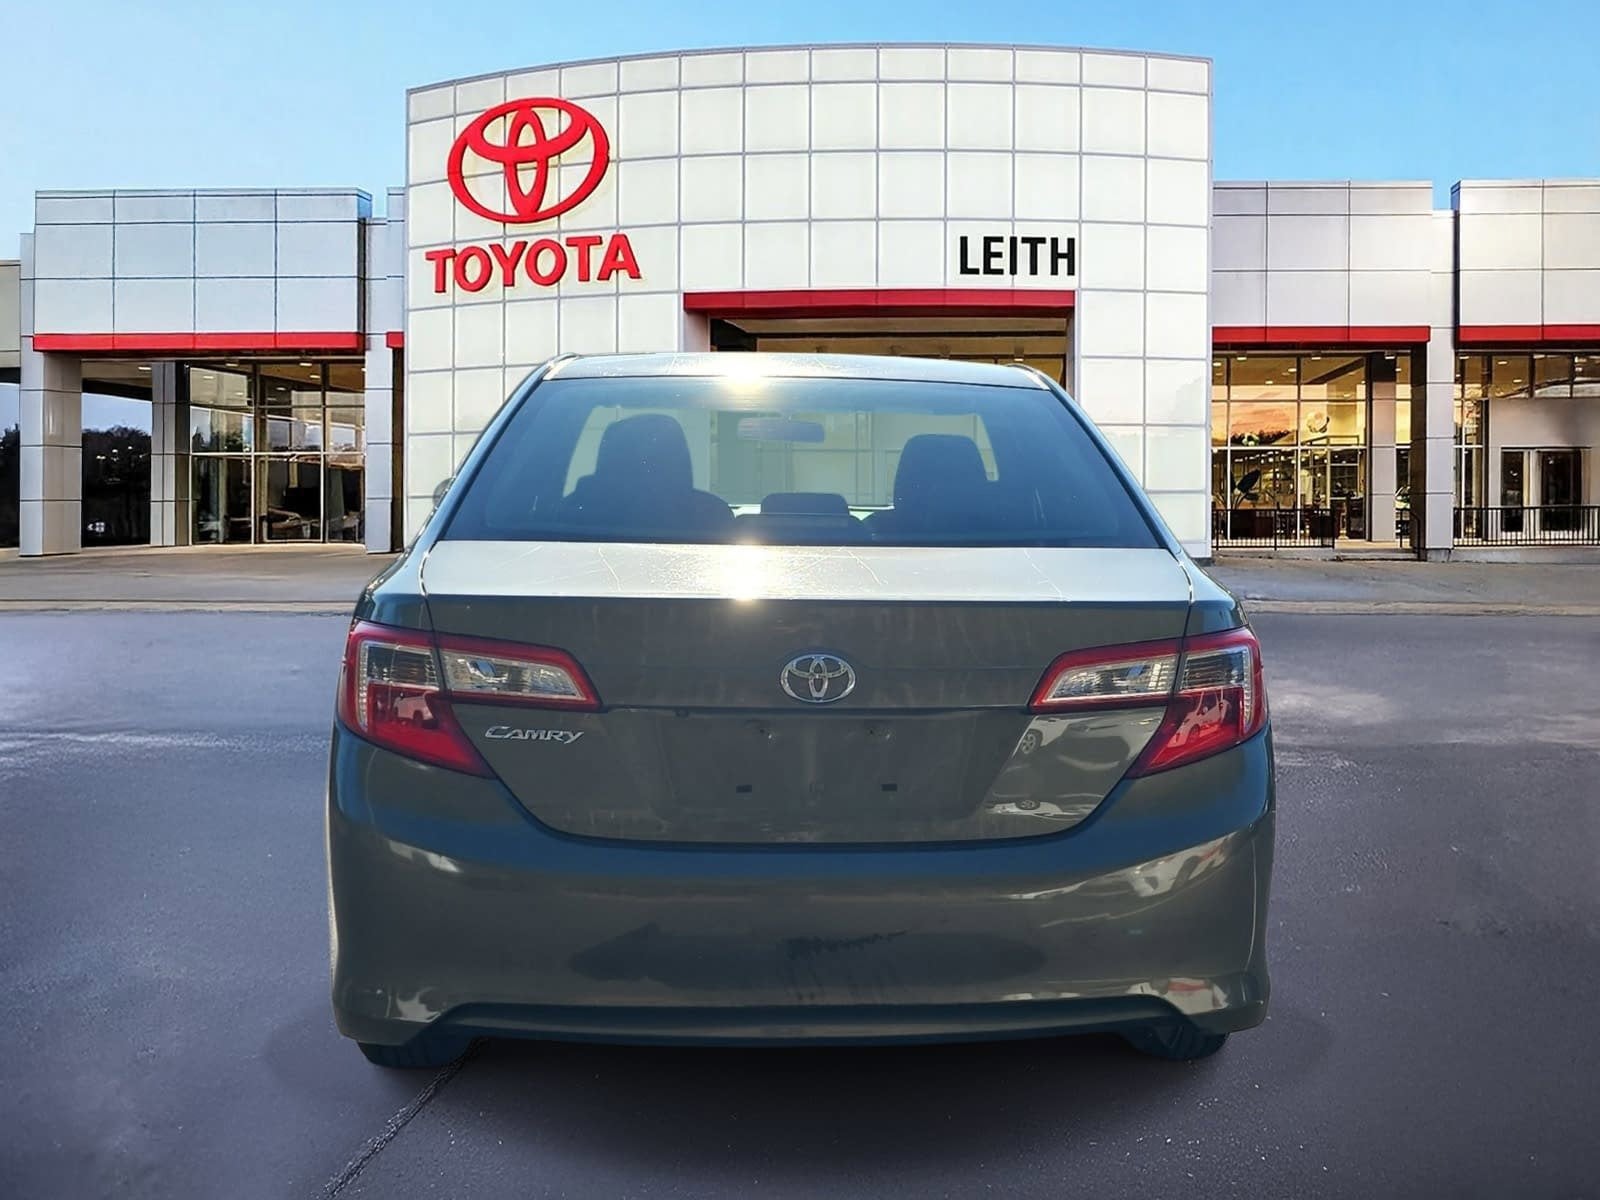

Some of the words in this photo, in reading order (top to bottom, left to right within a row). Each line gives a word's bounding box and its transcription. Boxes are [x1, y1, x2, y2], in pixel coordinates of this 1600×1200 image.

[425, 234, 641, 293] TOYOTA
[959, 236, 1076, 276] LEITH
[484, 725, 585, 745] CAMRY
